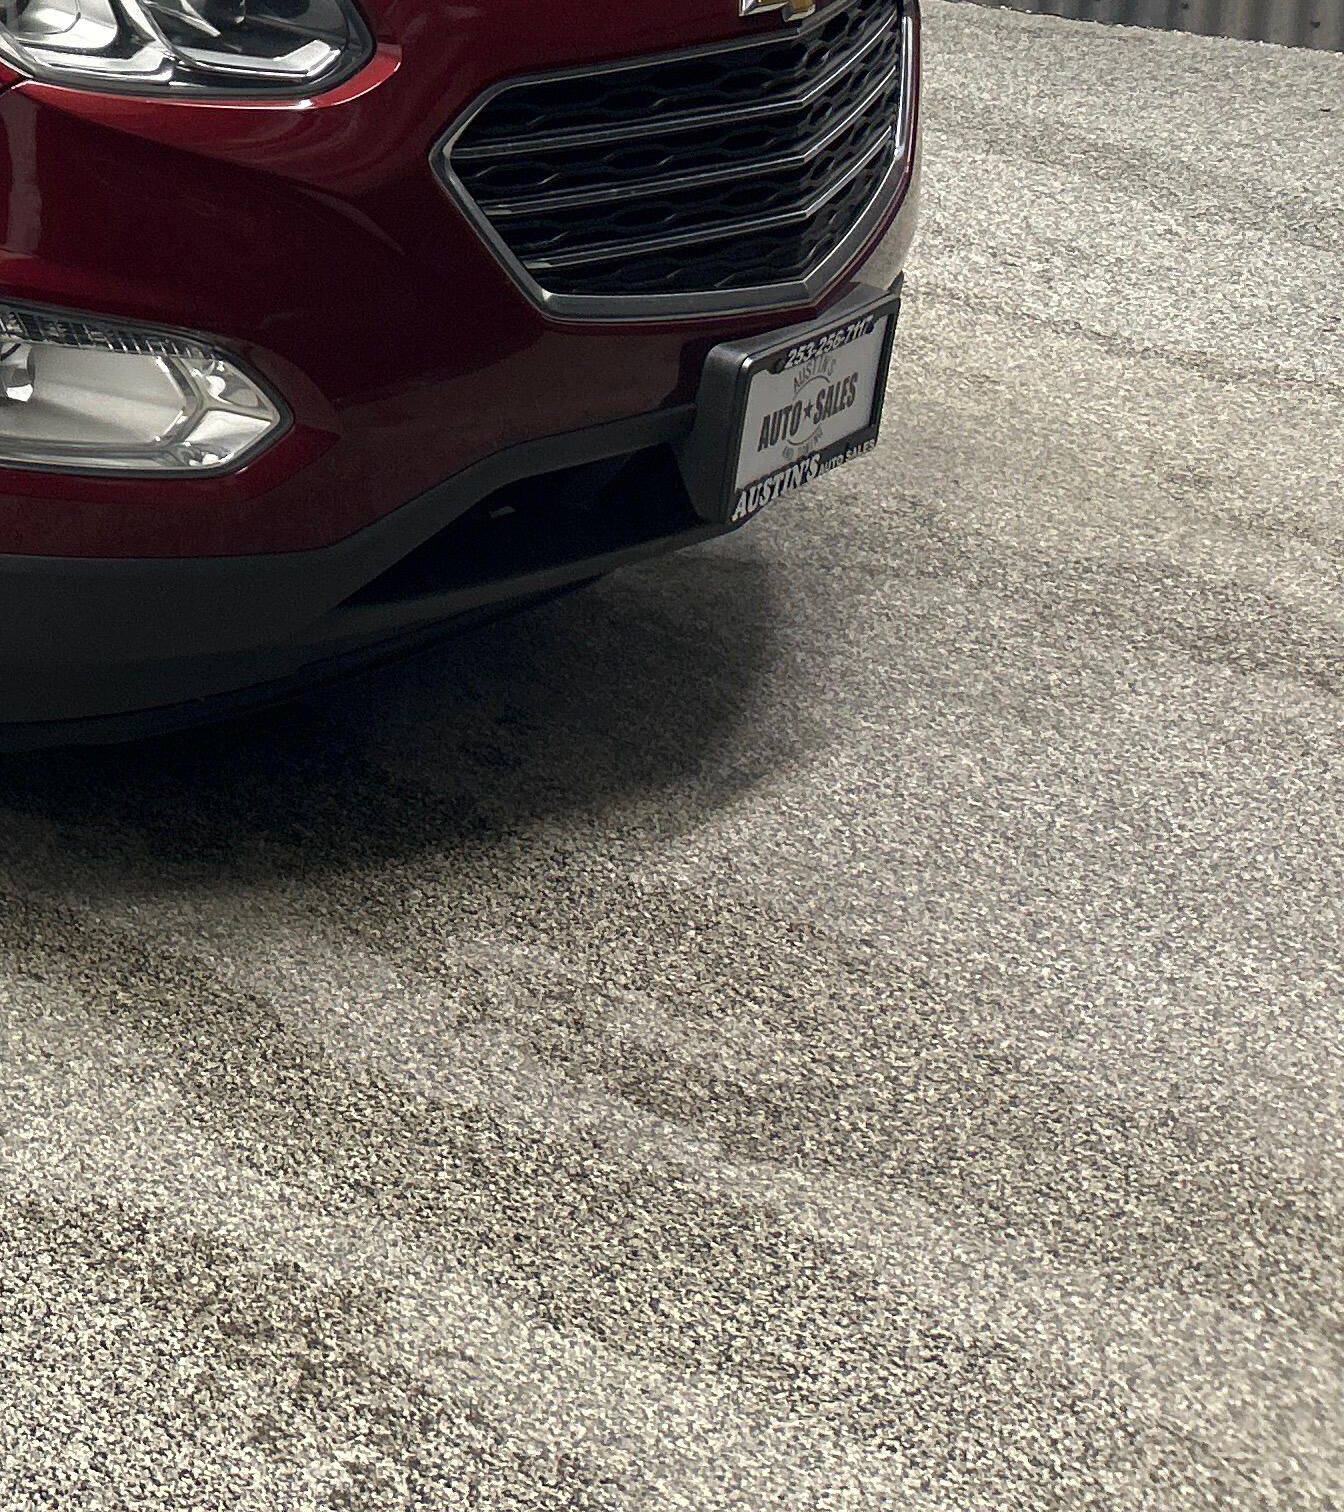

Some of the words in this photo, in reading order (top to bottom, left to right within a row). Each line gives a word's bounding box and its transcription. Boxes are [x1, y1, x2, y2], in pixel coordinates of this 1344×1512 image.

[757, 400, 803, 453] AUTO
[813, 372, 859, 425] SALES
[732, 453, 821, 522] AUSTIN'S
